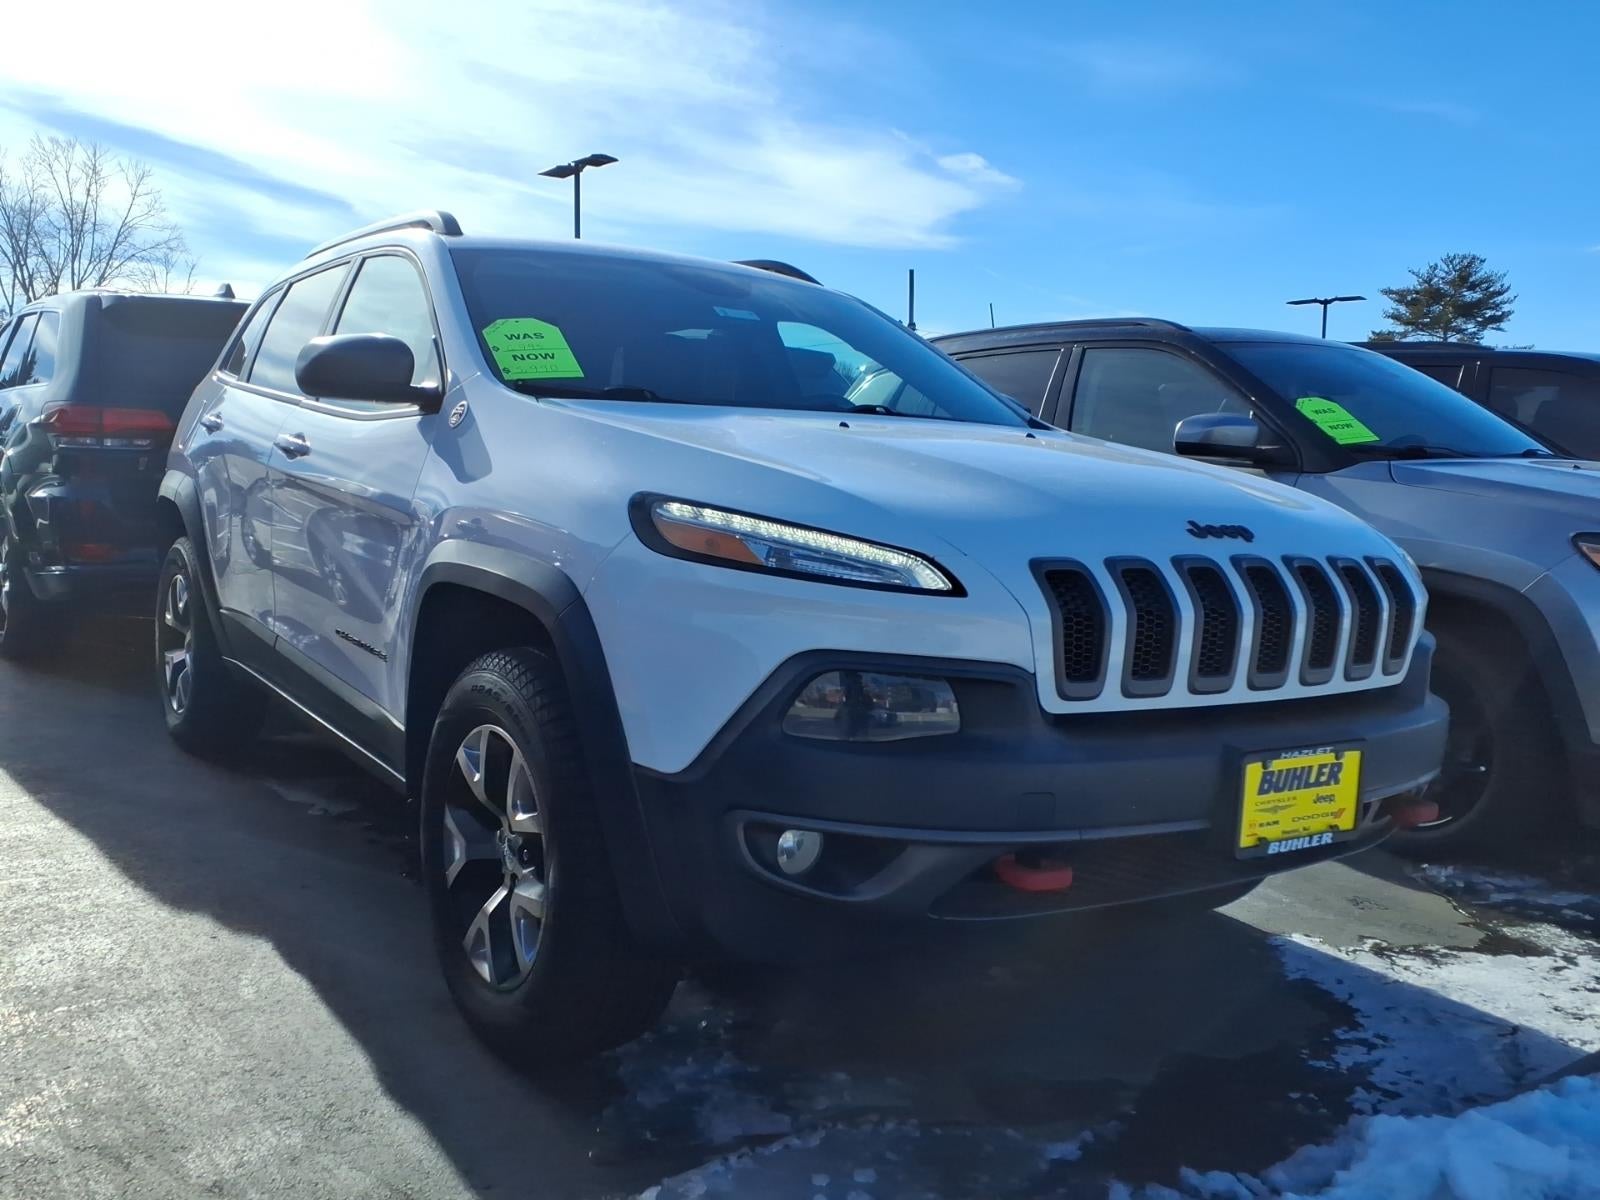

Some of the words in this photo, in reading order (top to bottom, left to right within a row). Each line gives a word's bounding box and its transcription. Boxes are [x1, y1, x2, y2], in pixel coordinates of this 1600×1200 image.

[504, 332, 545, 341] WAS
[511, 352, 555, 361] NOW
[1311, 407, 1337, 415] WAS
[1327, 422, 1353, 430] NOW
[1185, 519, 1255, 543] Jeep
[1280, 747, 1334, 758] HAZLET
[1258, 762, 1343, 795] BUHLER
[1312, 793, 1335, 804] Jeep
[1292, 811, 1337, 822] DODGE
[1267, 832, 1334, 854] BUHLER
